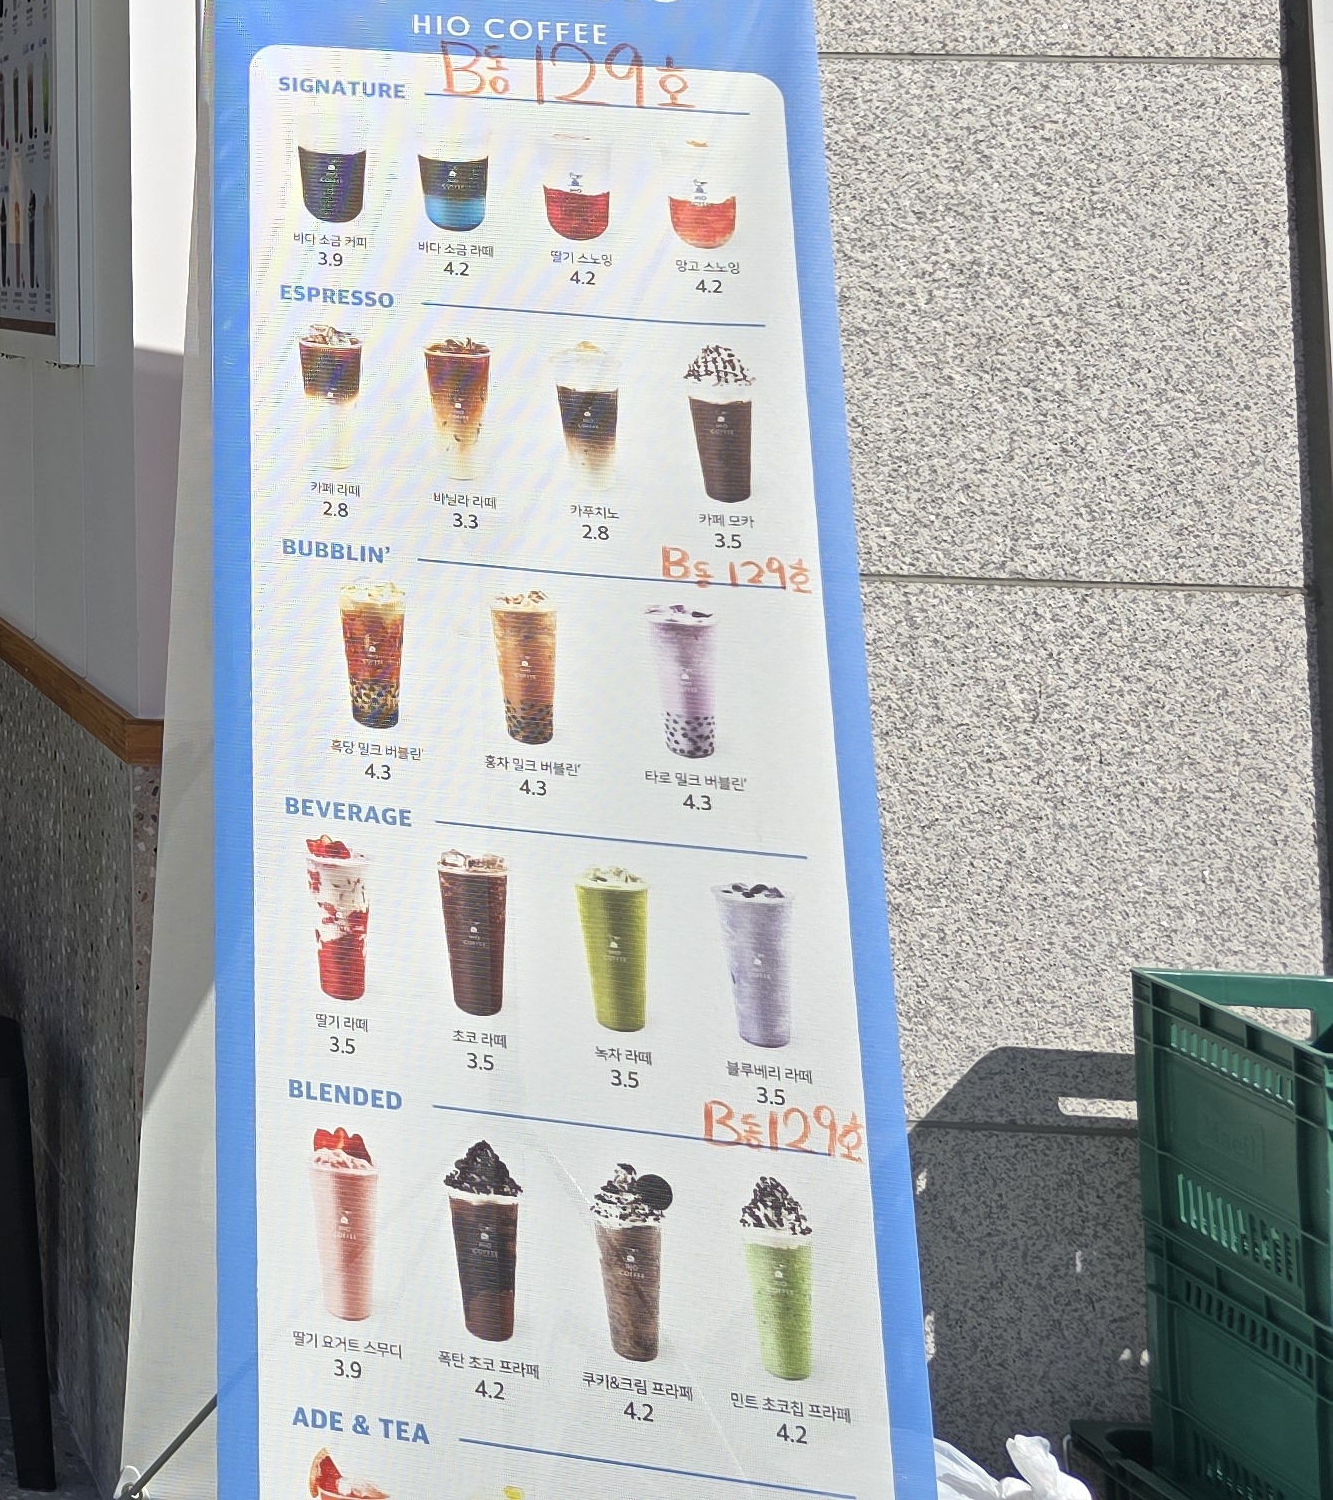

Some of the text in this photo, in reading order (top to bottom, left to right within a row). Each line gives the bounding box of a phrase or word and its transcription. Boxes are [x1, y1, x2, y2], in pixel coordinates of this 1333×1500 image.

[412, 13, 608, 46] HIO COFFEE
[278, 75, 406, 100] SIGNATURE
[318, 252, 343, 267] 3.9
[443, 262, 469, 277] 4.2
[675, 259, 700, 273] 망고
[570, 270, 596, 285] 4.2
[695, 279, 723, 294] 4.2
[279, 283, 395, 310] ESPRESSO
[322, 501, 349, 518] 2.8
[570, 505, 619, 520] 카푸치노
[698, 513, 725, 527] 카페
[452, 513, 479, 529] 3.3
[582, 525, 610, 540] 2.8
[714, 533, 742, 549] 3.5
[358, 742, 383, 757] 밀크
[364, 763, 392, 781] 4.3
[484, 754, 537, 773] 홍차 밀크
[519, 779, 548, 797] 4.3
[645, 769, 702, 787] 타로 밀크
[284, 796, 412, 829] BEVERAGE
[682, 794, 712, 812] 4.3
[315, 1012, 369, 1033] 딸기 라떼
[329, 1036, 356, 1055] 3.5
[452, 1028, 508, 1049] 초코 라떼
[466, 1051, 495, 1072] 3.5
[595, 1045, 653, 1067] 녹차 라떼
[610, 1068, 640, 1090] 3.5
[725, 1060, 813, 1086] 블루베리 라떼
[288, 1078, 403, 1111] BLENDED
[756, 1086, 786, 1107] 3.5
[292, 1330, 403, 1360] 딸기 요거트 스무디
[333, 1358, 363, 1380] 3.9
[438, 1350, 541, 1380] 폭탄 초코 프라페
[474, 1380, 506, 1402] 4.2
[582, 1370, 694, 1402] 쿠키&크림 프라페
[624, 1401, 655, 1425] 4.2
[730, 1392, 852, 1425] 민트 초코칩 프라페
[292, 1406, 430, 1445] ADE & TEA
[777, 1423, 809, 1446] 4.2
